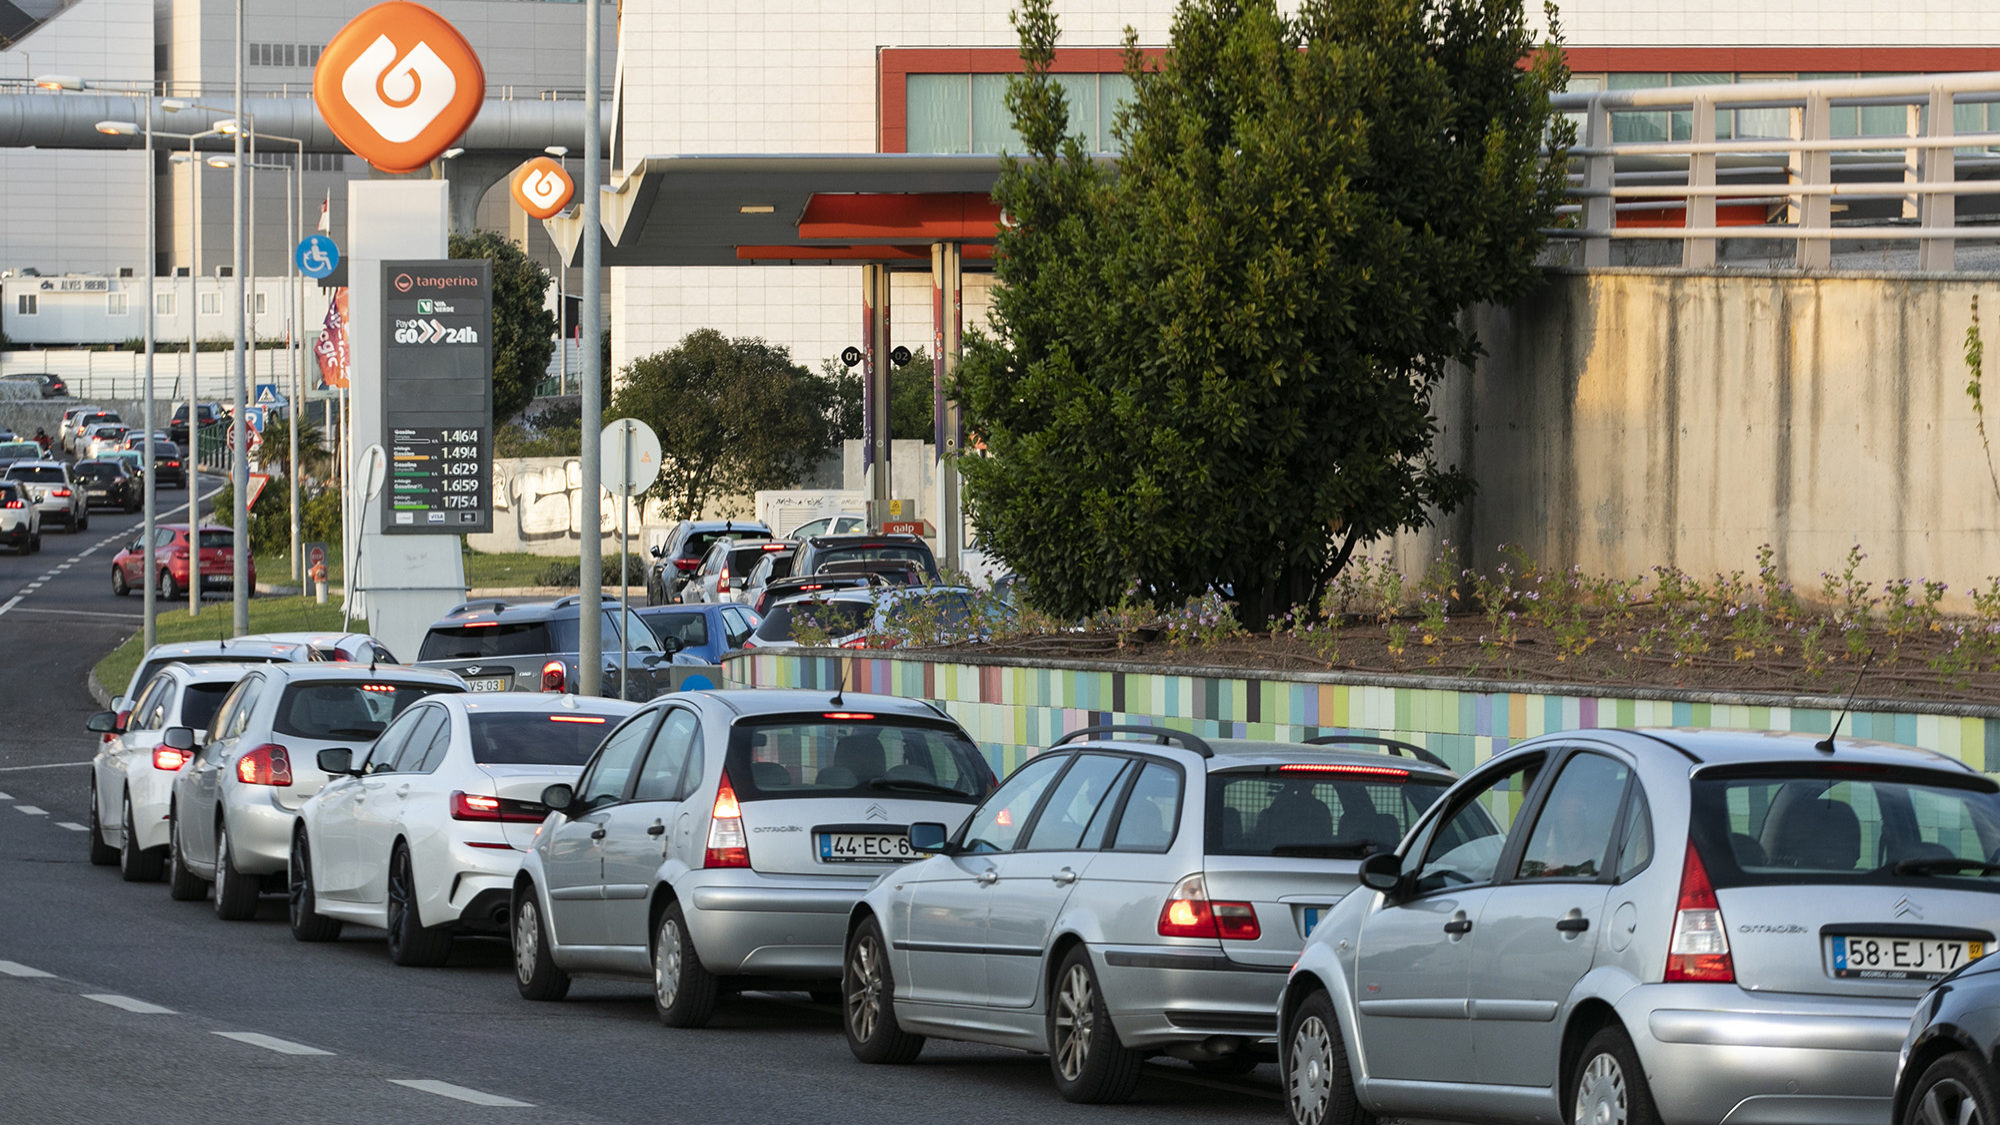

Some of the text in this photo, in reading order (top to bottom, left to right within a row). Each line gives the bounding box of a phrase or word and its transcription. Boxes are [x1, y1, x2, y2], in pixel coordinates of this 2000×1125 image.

[416, 275, 478, 289] tangerina
[394, 326, 478, 343] GO 24h
[845, 352, 858, 361] 01
[895, 352, 908, 361] 02
[229, 430, 253, 443] SP
[441, 430, 478, 442] 1.464
[441, 446, 477, 459] 1.494
[442, 463, 478, 475] 1.629
[441, 479, 478, 491] 1.659
[893, 523, 914, 534] galp
[487, 681, 499, 690] 03
